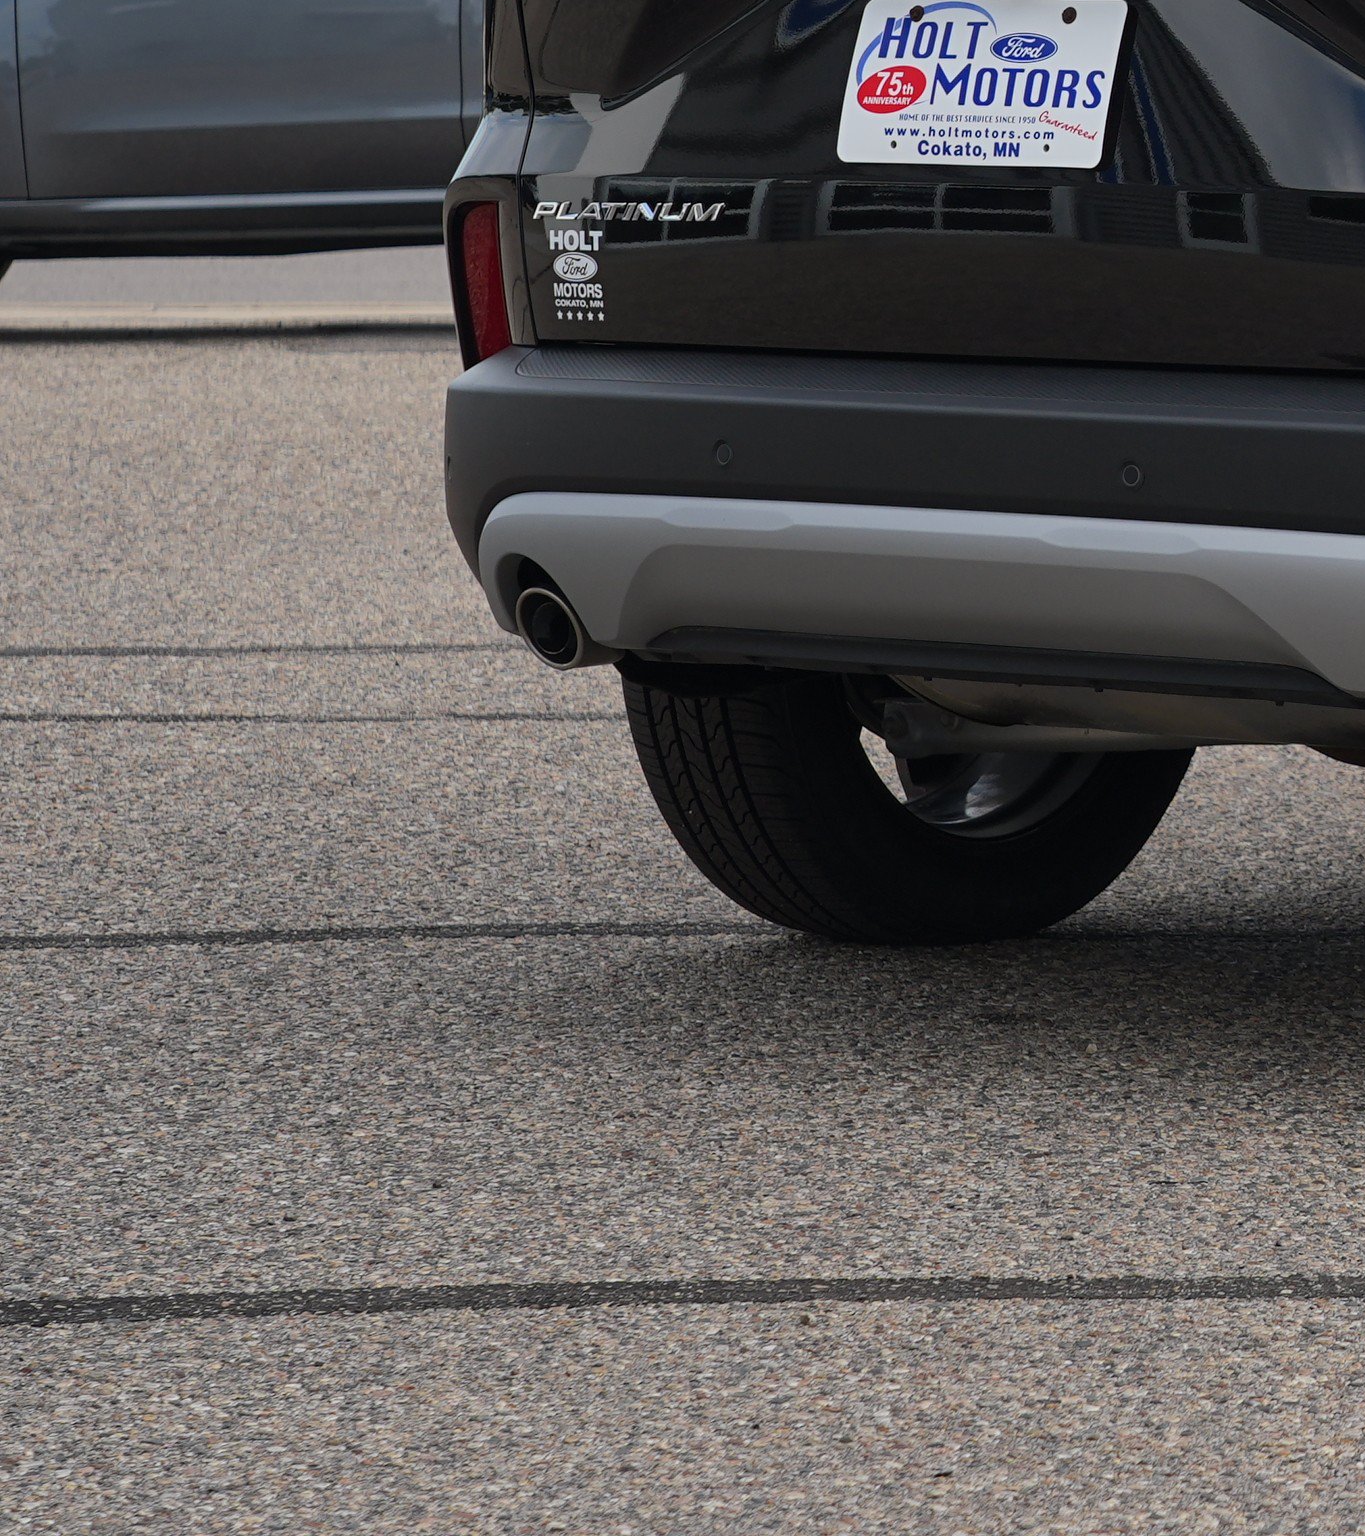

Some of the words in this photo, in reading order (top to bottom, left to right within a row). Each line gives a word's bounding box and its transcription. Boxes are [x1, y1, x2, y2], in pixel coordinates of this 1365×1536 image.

[878, 16, 988, 60] HOLT
[999, 35, 1049, 60] Ford
[875, 71, 915, 97] 75th
[929, 63, 1106, 109] MOTORS
[862, 95, 912, 106] ANNIVERSARY
[899, 113, 919, 122] HOME
[921, 114, 930, 122] OF
[932, 114, 944, 122] THE
[946, 115, 963, 123] BEST
[964, 115, 992, 123] SERVICE
[995, 116, 1016, 124] SINCE
[1018, 116, 1036, 124] 1950
[1038, 110, 1098, 141] Guaranteed
[884, 126, 1055, 141] www.holtmotors.com
[917, 139, 988, 161] Cokato,
[993, 142, 1021, 158] MN
[533, 201, 726, 222] PLATINUM
[549, 229, 603, 251] HOLT
[561, 255, 591, 277] Ford
[553, 282, 603, 299] MOTORS
[554, 298, 589, 309] COKATO,
[590, 300, 604, 309] MN
